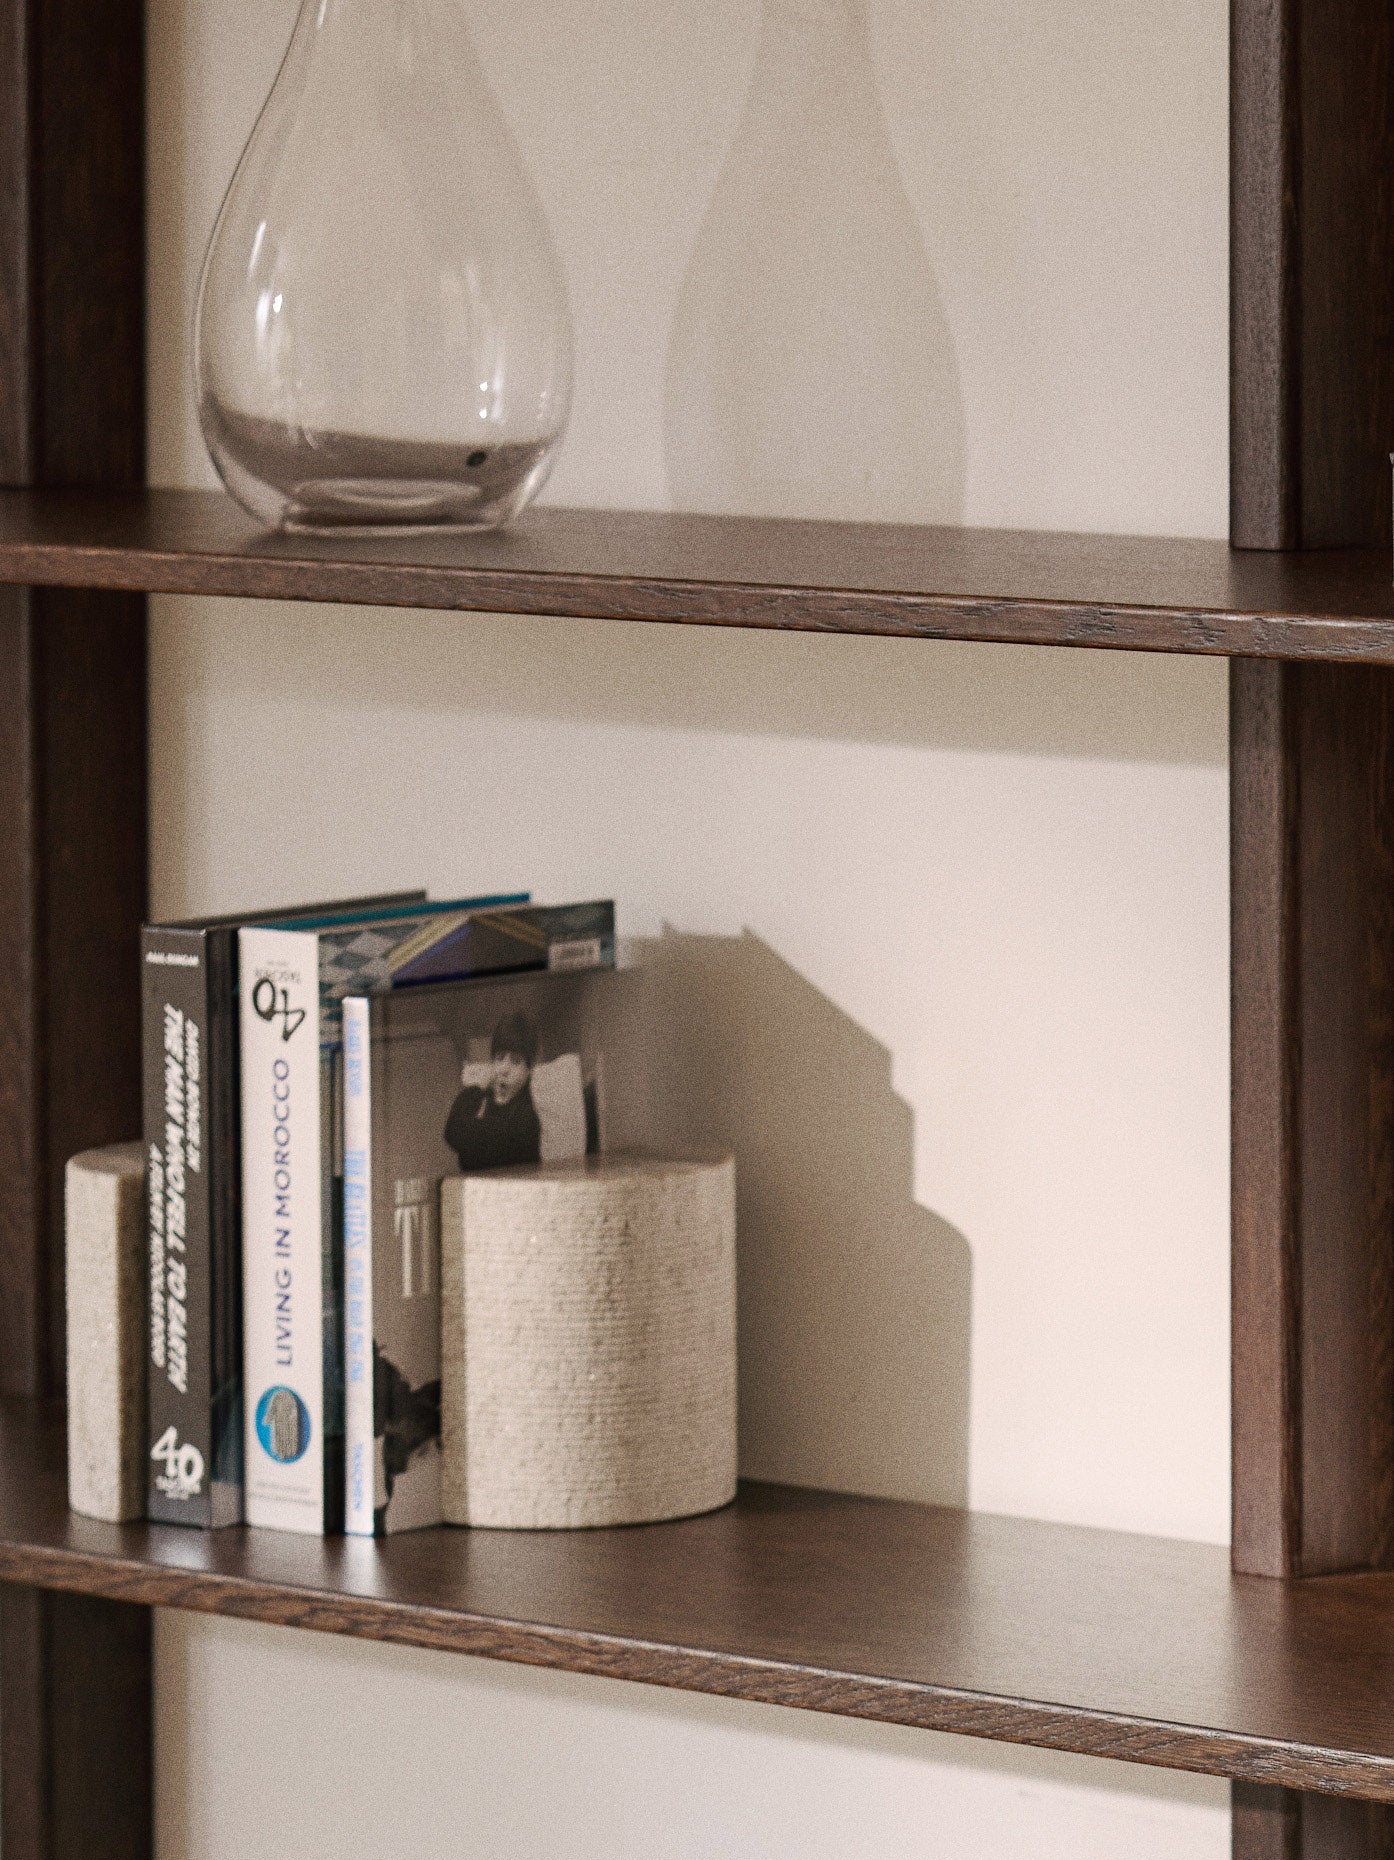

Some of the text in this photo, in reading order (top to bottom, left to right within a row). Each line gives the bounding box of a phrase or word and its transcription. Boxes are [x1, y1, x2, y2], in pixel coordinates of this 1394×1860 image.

[164, 1003, 188, 1394] THE MAN WHO FELL TO EARTH
[273, 1059, 293, 1366] LIVING IN MOROCCO
[150, 1425, 205, 1484] 40
